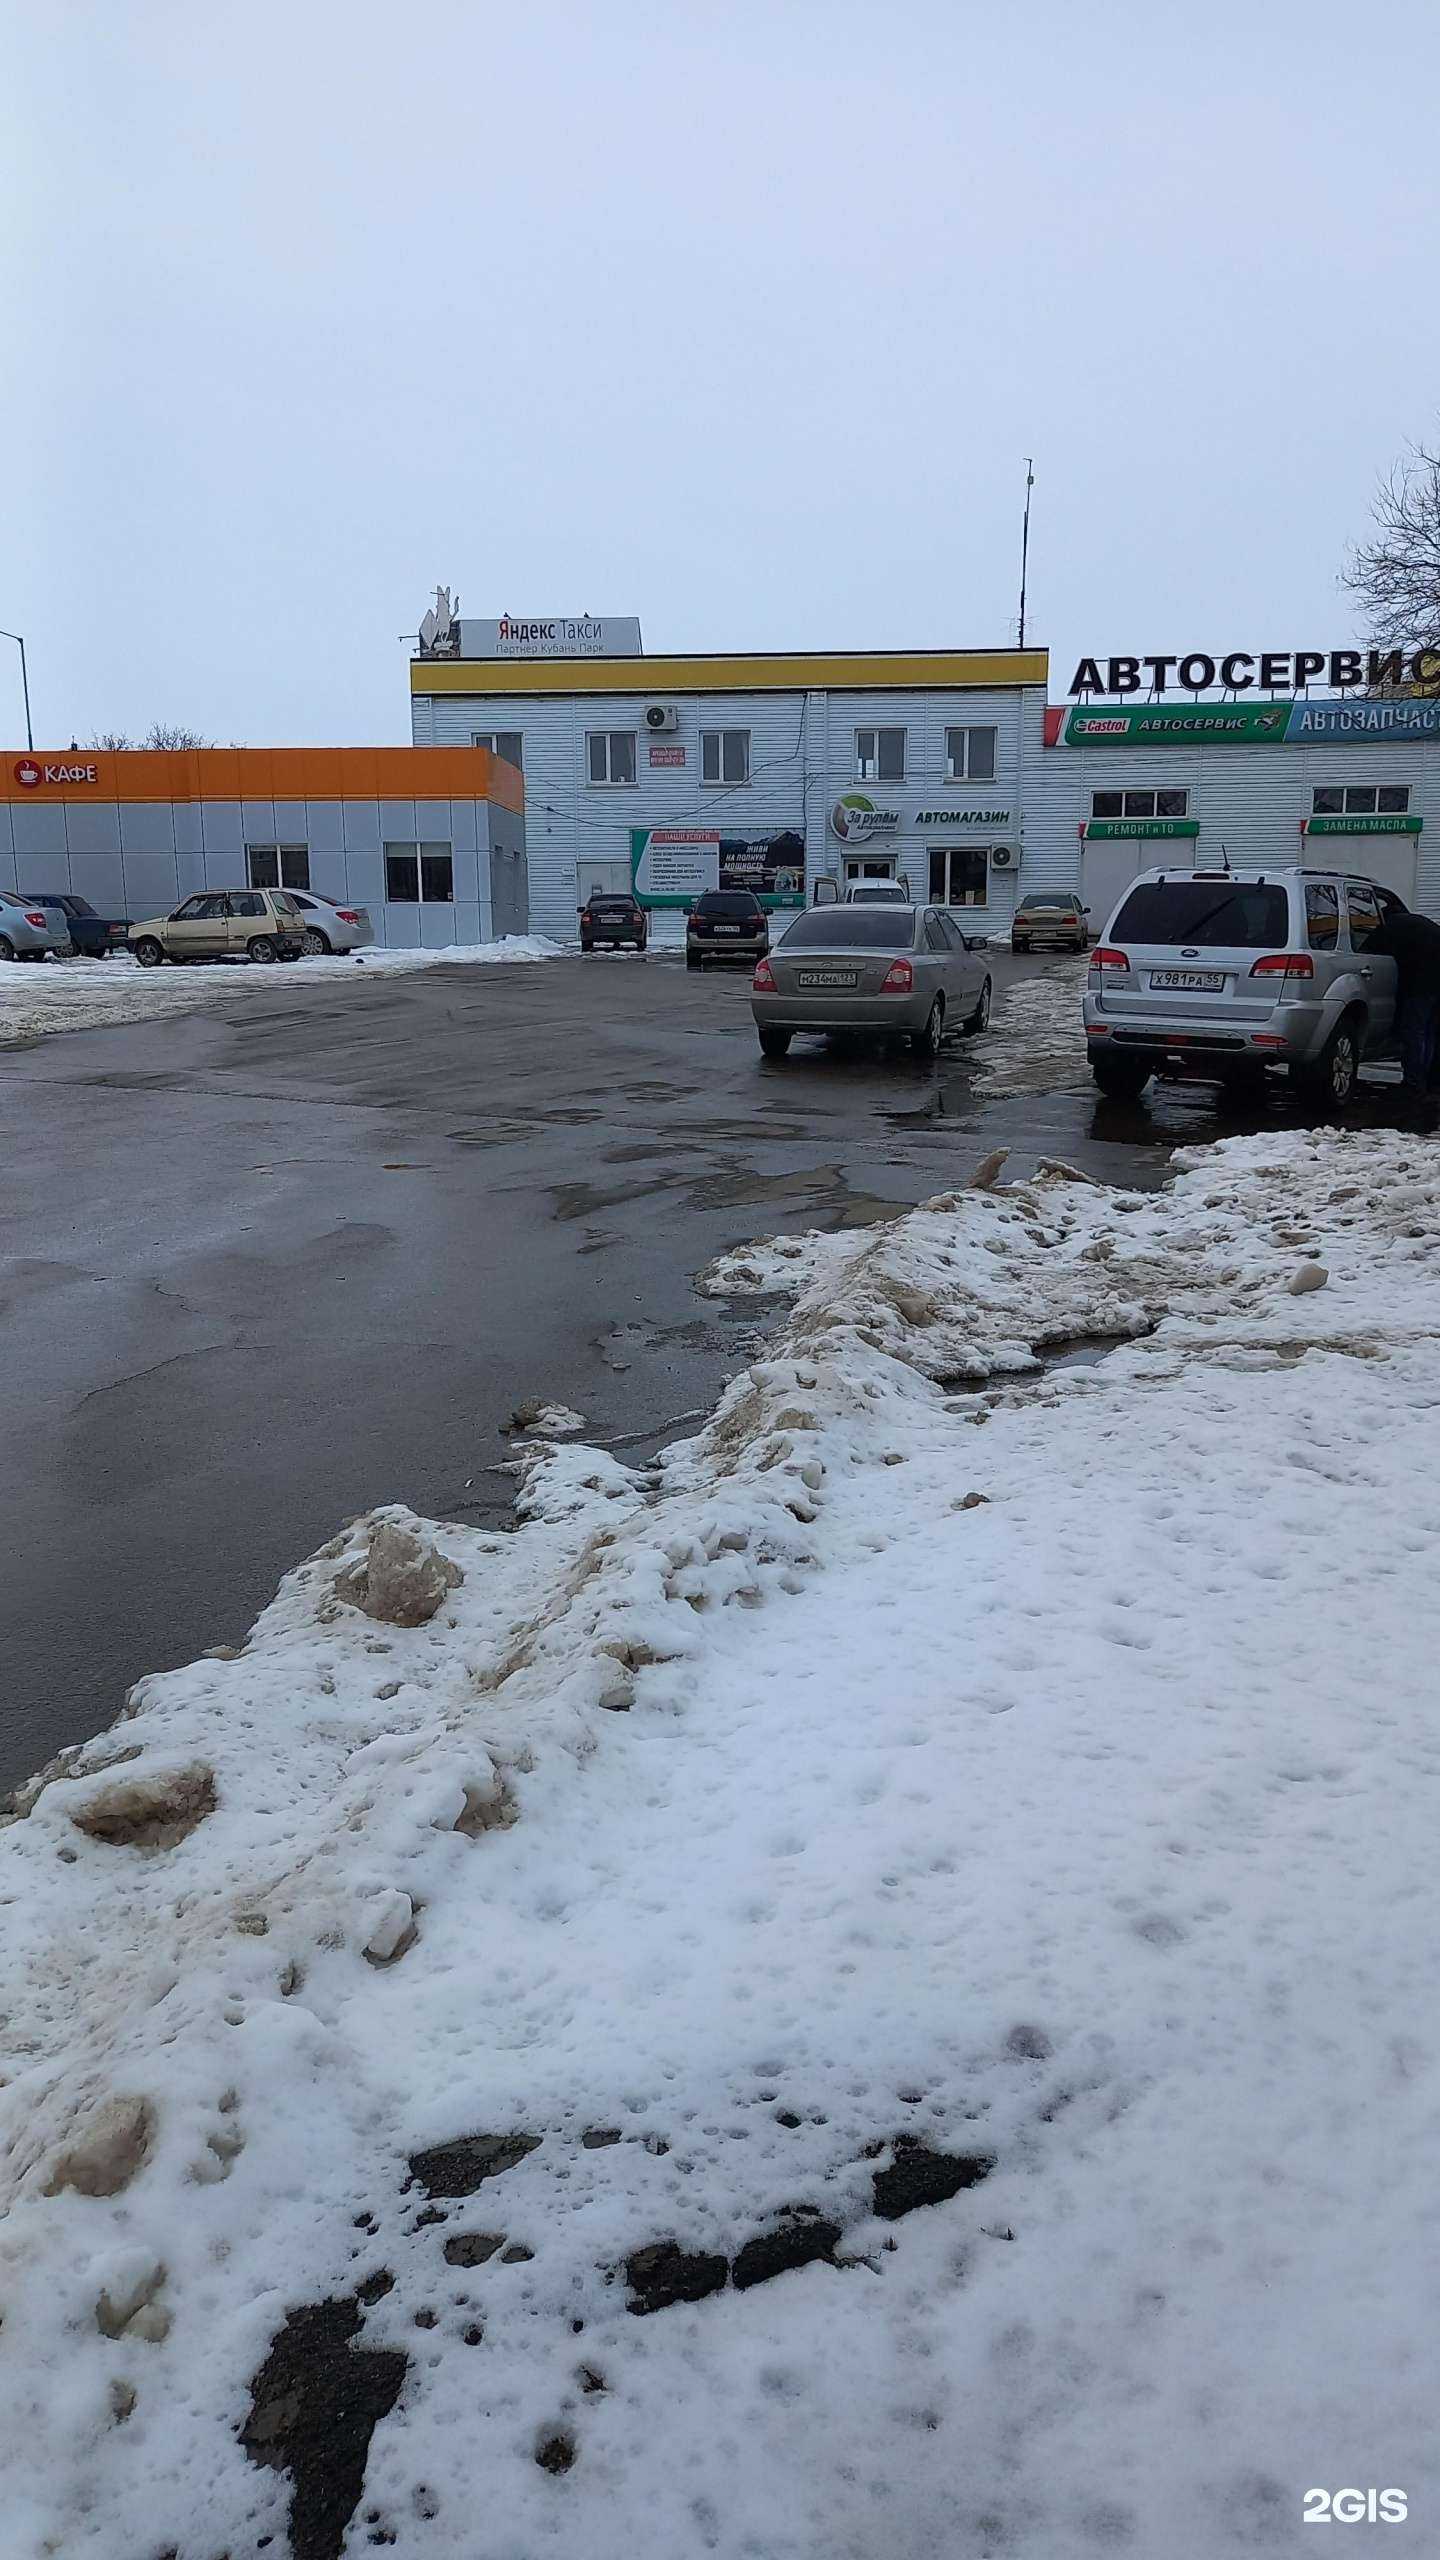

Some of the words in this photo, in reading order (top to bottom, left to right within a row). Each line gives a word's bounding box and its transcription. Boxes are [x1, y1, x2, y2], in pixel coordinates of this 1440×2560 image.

[499, 620, 556, 642] Яндекс
[560, 619, 603, 639] Такси
[496, 644, 538, 655] Партнер
[541, 643, 577, 654] Кубань
[579, 643, 604, 653] Парк
[1067, 649, 1440, 696] АВТОСЕРВИС
[1087, 719, 1127, 732] Castrol
[1139, 717, 1248, 731] АВТОСЕРВИС
[44, 764, 98, 782] КАФЕ
[847, 810, 862, 824] За
[915, 811, 1010, 824] АВТОМАГАЗИН
[1107, 823, 1152, 834] РЕМОНТ
[1162, 823, 1174, 834] ТО
[1323, 819, 1368, 831] ЗАМЕНА
[1369, 818, 1408, 831] МАСЛА
[746, 845, 769, 853] ЖИВИ
[736, 853, 767, 862] ПОЛНУЮ
